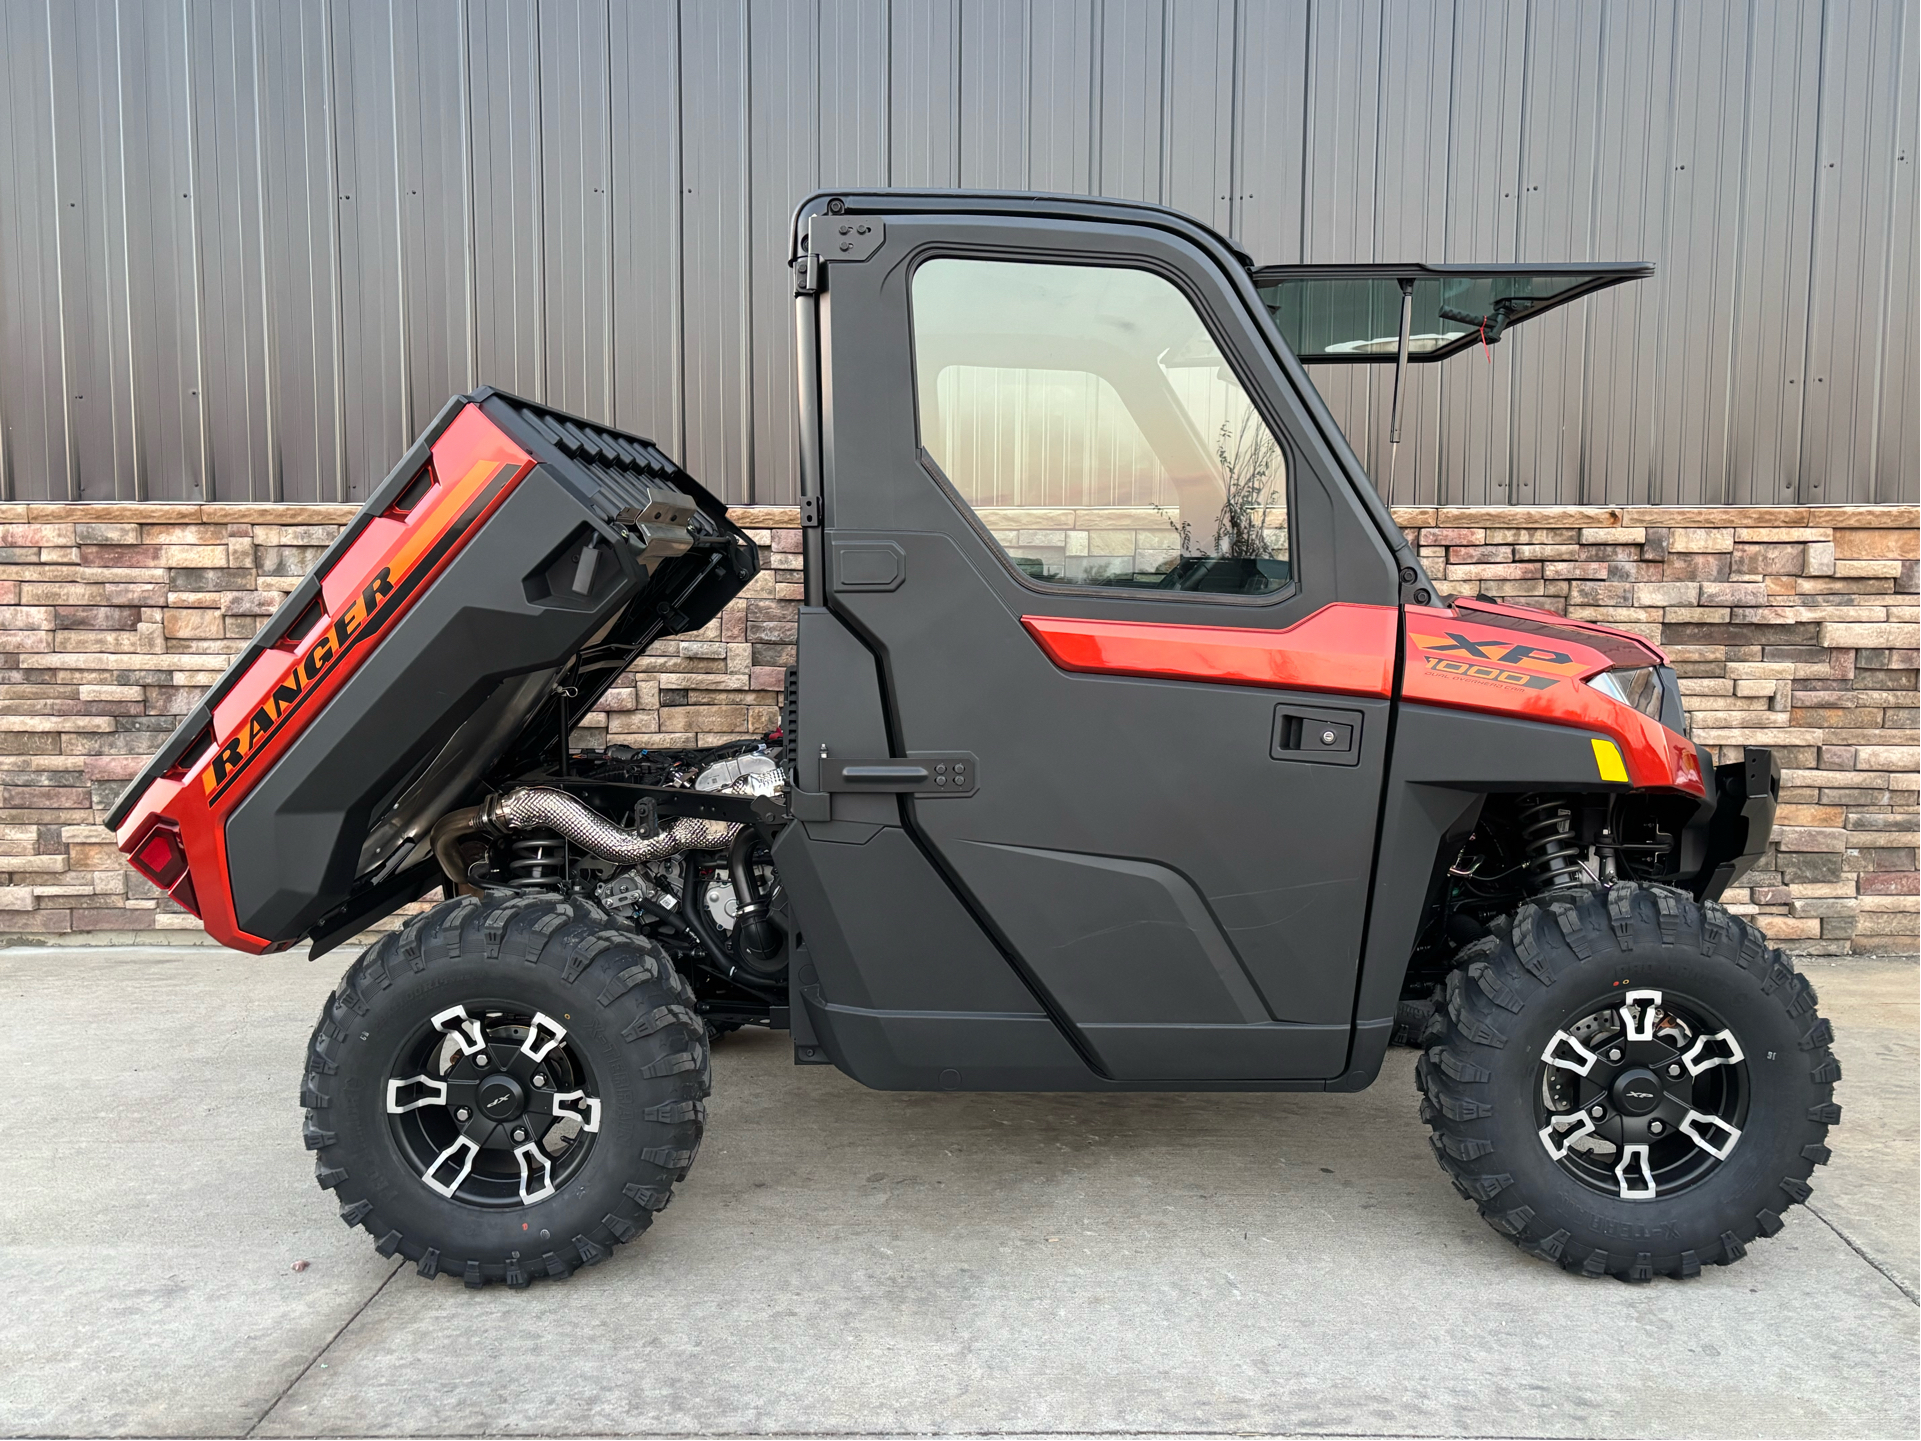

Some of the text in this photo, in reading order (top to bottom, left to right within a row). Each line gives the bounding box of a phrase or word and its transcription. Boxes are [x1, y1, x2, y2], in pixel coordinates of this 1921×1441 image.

[1422, 632, 1574, 664] XP
[209, 566, 396, 787] RANGER
[1424, 671, 1526, 693] DUAL OVERHEAD CAM
[1426, 657, 1532, 685] 1000
[582, 1018, 634, 1146] X-TERRAIN
[487, 1094, 511, 1108] XP
